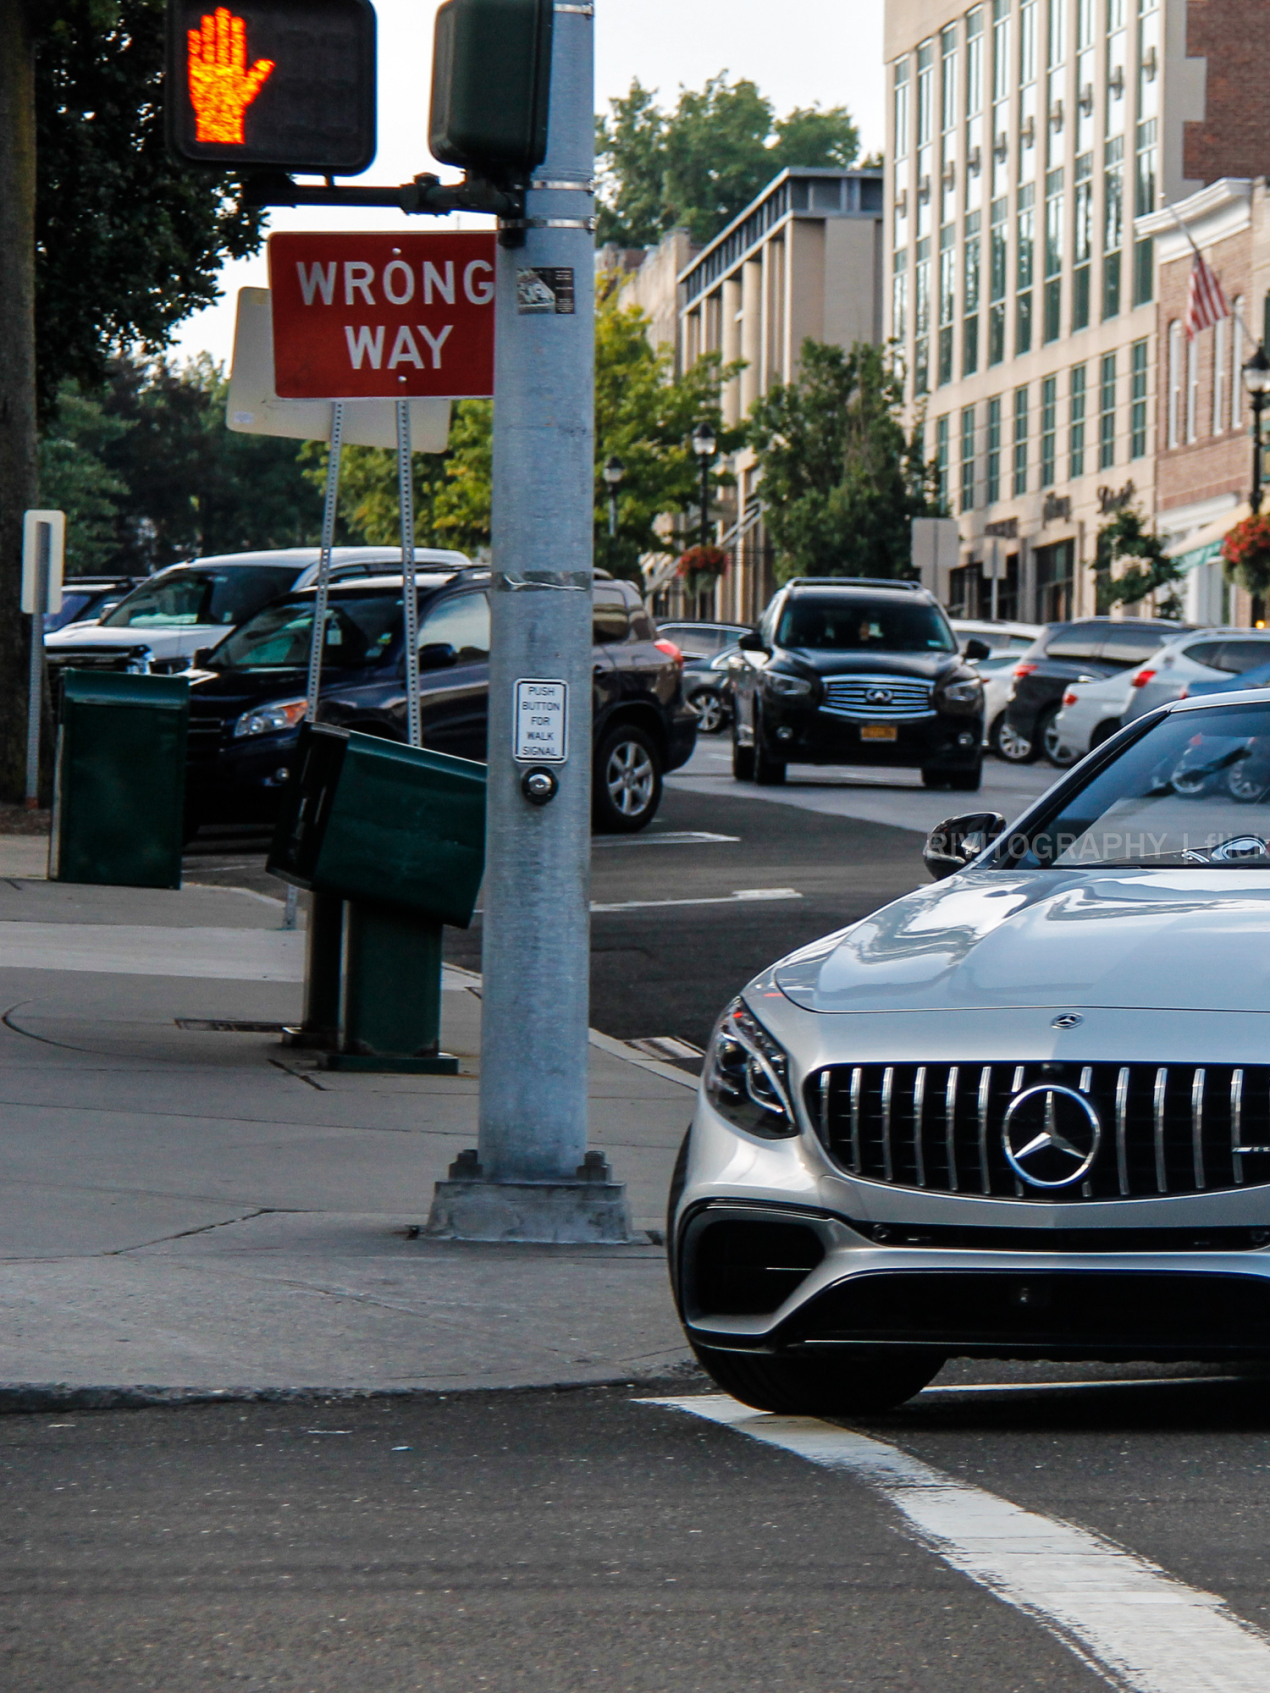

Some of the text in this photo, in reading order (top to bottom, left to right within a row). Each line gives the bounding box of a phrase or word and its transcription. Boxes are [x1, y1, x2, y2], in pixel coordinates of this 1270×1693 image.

[296, 259, 496, 306] WRONG
[344, 325, 454, 370] WAY
[528, 686, 555, 696] PUSH
[522, 701, 560, 711] BUTTON
[531, 716, 550, 726] FOR
[527, 731, 554, 741] WALK
[522, 746, 558, 756] SIGNAL
